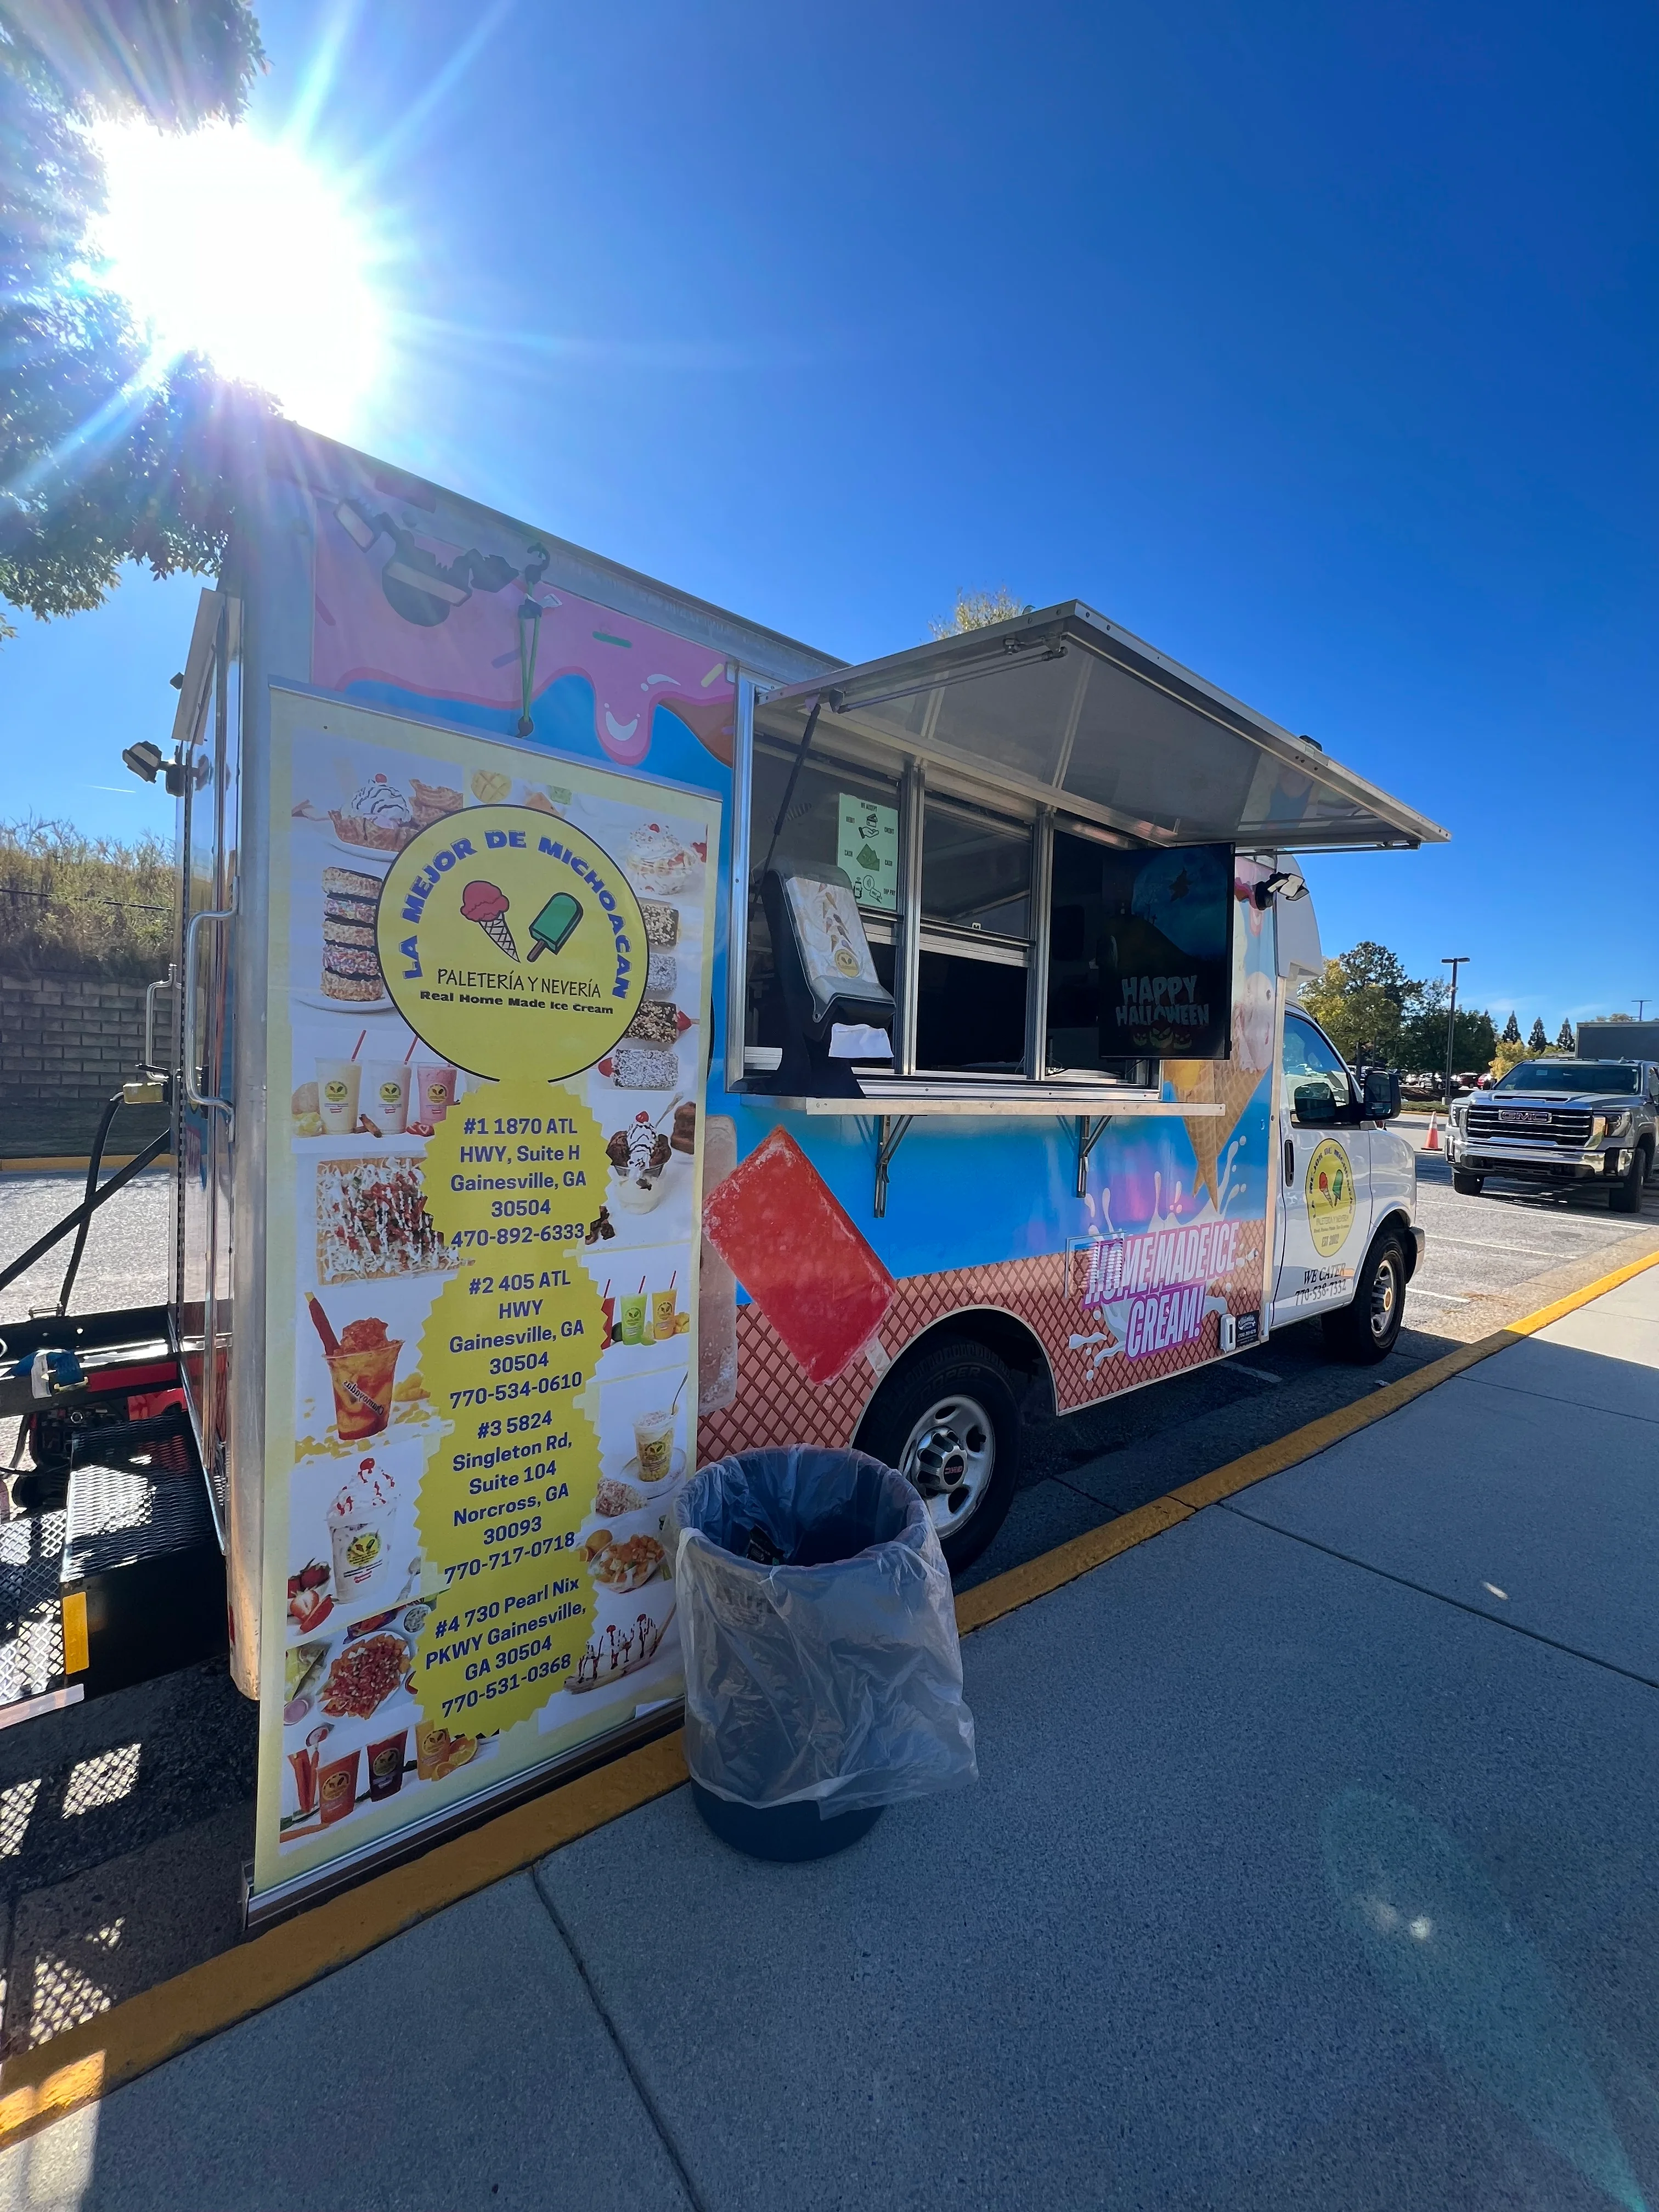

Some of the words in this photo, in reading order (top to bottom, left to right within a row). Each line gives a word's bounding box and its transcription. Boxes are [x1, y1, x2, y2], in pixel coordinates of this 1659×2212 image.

[484, 829, 527, 849] DE
[400, 837, 478, 924] MEJOR
[538, 834, 632, 999] MICHOACAN
[398, 935, 424, 980] LA
[437, 968, 524, 991] PALETERÍA
[528, 977, 538, 992] Y
[541, 978, 602, 998] NEVERÍA
[1121, 975, 1198, 1006] HAPPY
[420, 990, 454, 1003] Real
[459, 993, 504, 1006] Home
[508, 996, 546, 1010] Made
[550, 1001, 568, 1011] Ice
[572, 1003, 614, 1014] Cream
[1116, 1003, 1210, 1028] HALLOWEEN
[464, 1118, 489, 1135] #1
[494, 1118, 542, 1135] 1870
[546, 1118, 578, 1135] ATL
[1502, 1111, 1549, 1122] GMC
[460, 1146, 512, 1165] HWY,
[517, 1144, 565, 1161] Suite
[569, 1144, 580, 1161] H
[450, 1171, 558, 1192] Gainesville,
[563, 1170, 586, 1187] GA
[491, 1199, 551, 1217] 30504
[451, 1223, 585, 1248] 470-892-6333
[1209, 1221, 1240, 1276] ICE
[469, 1277, 494, 1295] #2
[498, 1273, 535, 1291] 405
[539, 1270, 571, 1289] ATL
[1304, 1269, 1318, 1285] WE
[1319, 1262, 1346, 1281] CATER
[1295, 1279, 1346, 1306] 770-538-7332
[499, 1299, 543, 1319] HWY
[1127, 1284, 1205, 1358] CREAM!
[449, 1328, 557, 1353] Gainesville,
[561, 1319, 585, 1337] GA
[489, 1351, 549, 1375] 30504
[450, 1371, 583, 1409] 770-534-0610
[477, 1421, 501, 1440] #3
[506, 1410, 552, 1434] 5824
[453, 1441, 542, 1472] Singleton
[546, 1432, 573, 1452] Rd,
[469, 1468, 520, 1496] Suite
[523, 1460, 557, 1483] 104
[454, 1495, 541, 1527] Norcross,
[545, 1482, 569, 1502] GA
[483, 1516, 543, 1545] 30093
[444, 1531, 575, 1584] 770-717-0718
[435, 1616, 460, 1639] #4
[465, 1602, 499, 1628] 730
[504, 1584, 548, 1615] Pearl
[552, 1576, 580, 1600] Nix
[425, 1633, 484, 1671] PKWY
[488, 1602, 586, 1647] Gainesville,
[465, 1660, 491, 1681] GA
[495, 1635, 552, 1671] 30504
[442, 1653, 572, 1718] 770-531-0368
